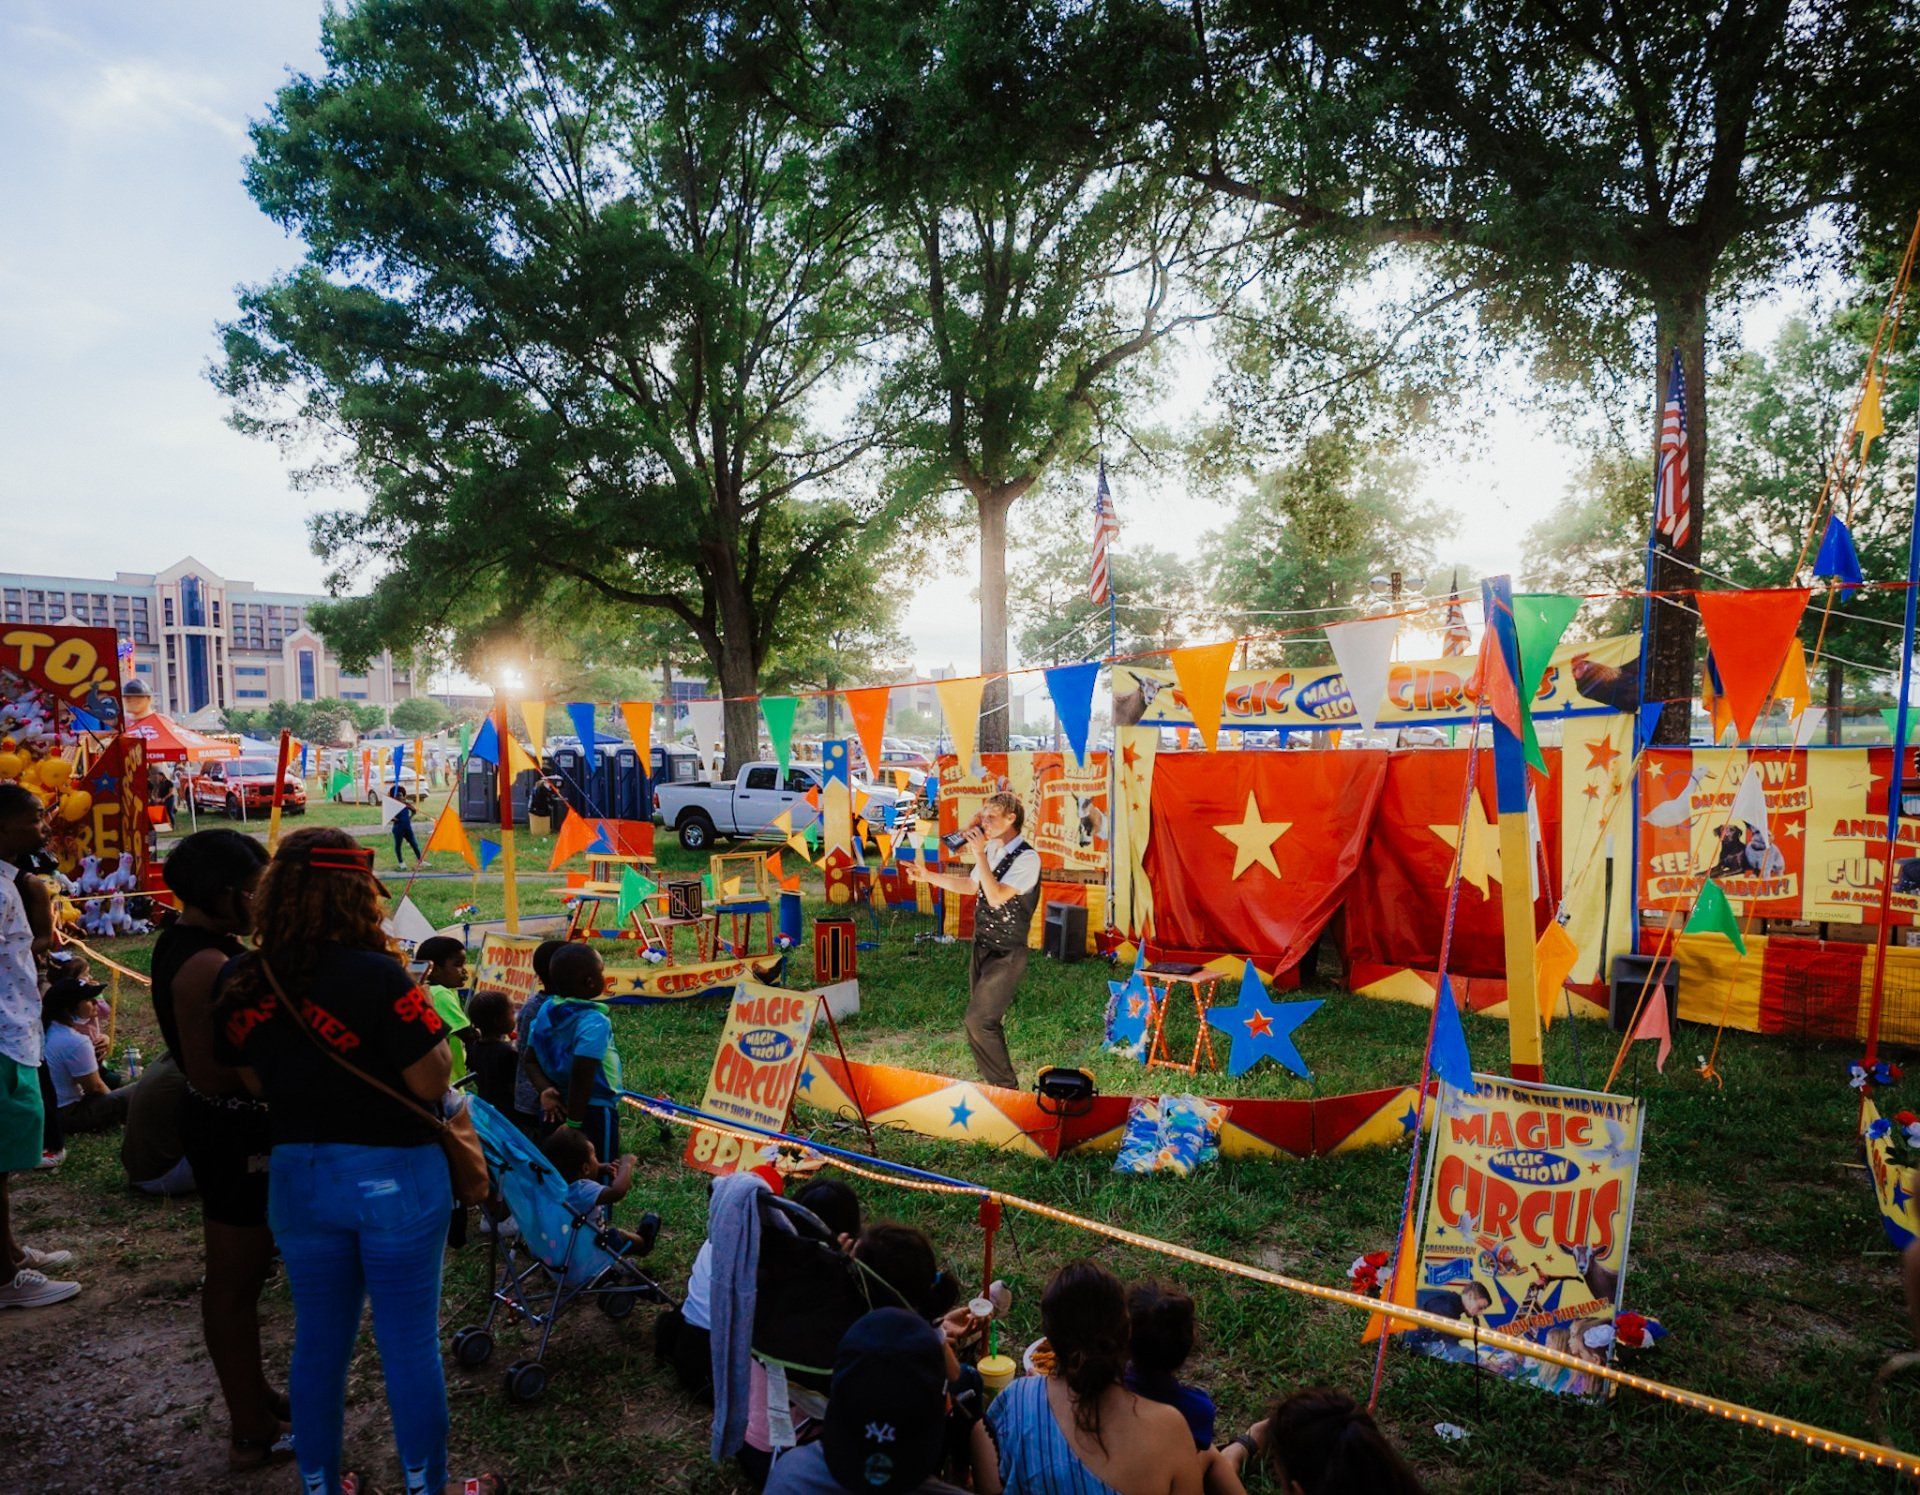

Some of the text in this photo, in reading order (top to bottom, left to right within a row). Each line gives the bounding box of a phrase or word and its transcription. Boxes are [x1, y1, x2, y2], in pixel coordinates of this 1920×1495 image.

[1313, 696, 1354, 722] SHO
[1764, 790, 1807, 809] UCKS!
[1852, 890, 1919, 909] AMAING
[657, 963, 745, 994] CIRCUS
[735, 996, 805, 1026] MAGIC
[745, 1031, 776, 1045] MAGIC
[750, 1040, 788, 1059] SHOW
[715, 1043, 799, 1111] CIRCUS
[709, 1098, 730, 1111] NEXT
[730, 1103, 753, 1119] SHOW
[1496, 1084, 1509, 1098] IT
[1511, 1089, 1530, 1103] ON
[1530, 1093, 1562, 1109] THE
[1563, 1097, 1634, 1125] MIDWAY!
[1450, 1111, 1592, 1150] MAGIC
[1493, 1152, 1545, 1167] MAGIC
[1514, 1158, 1571, 1181] SHOW
[1437, 1154, 1622, 1261] CIRCUS
[1530, 1311, 1555, 1329] FOR
[1554, 1305, 1578, 1324] THE
